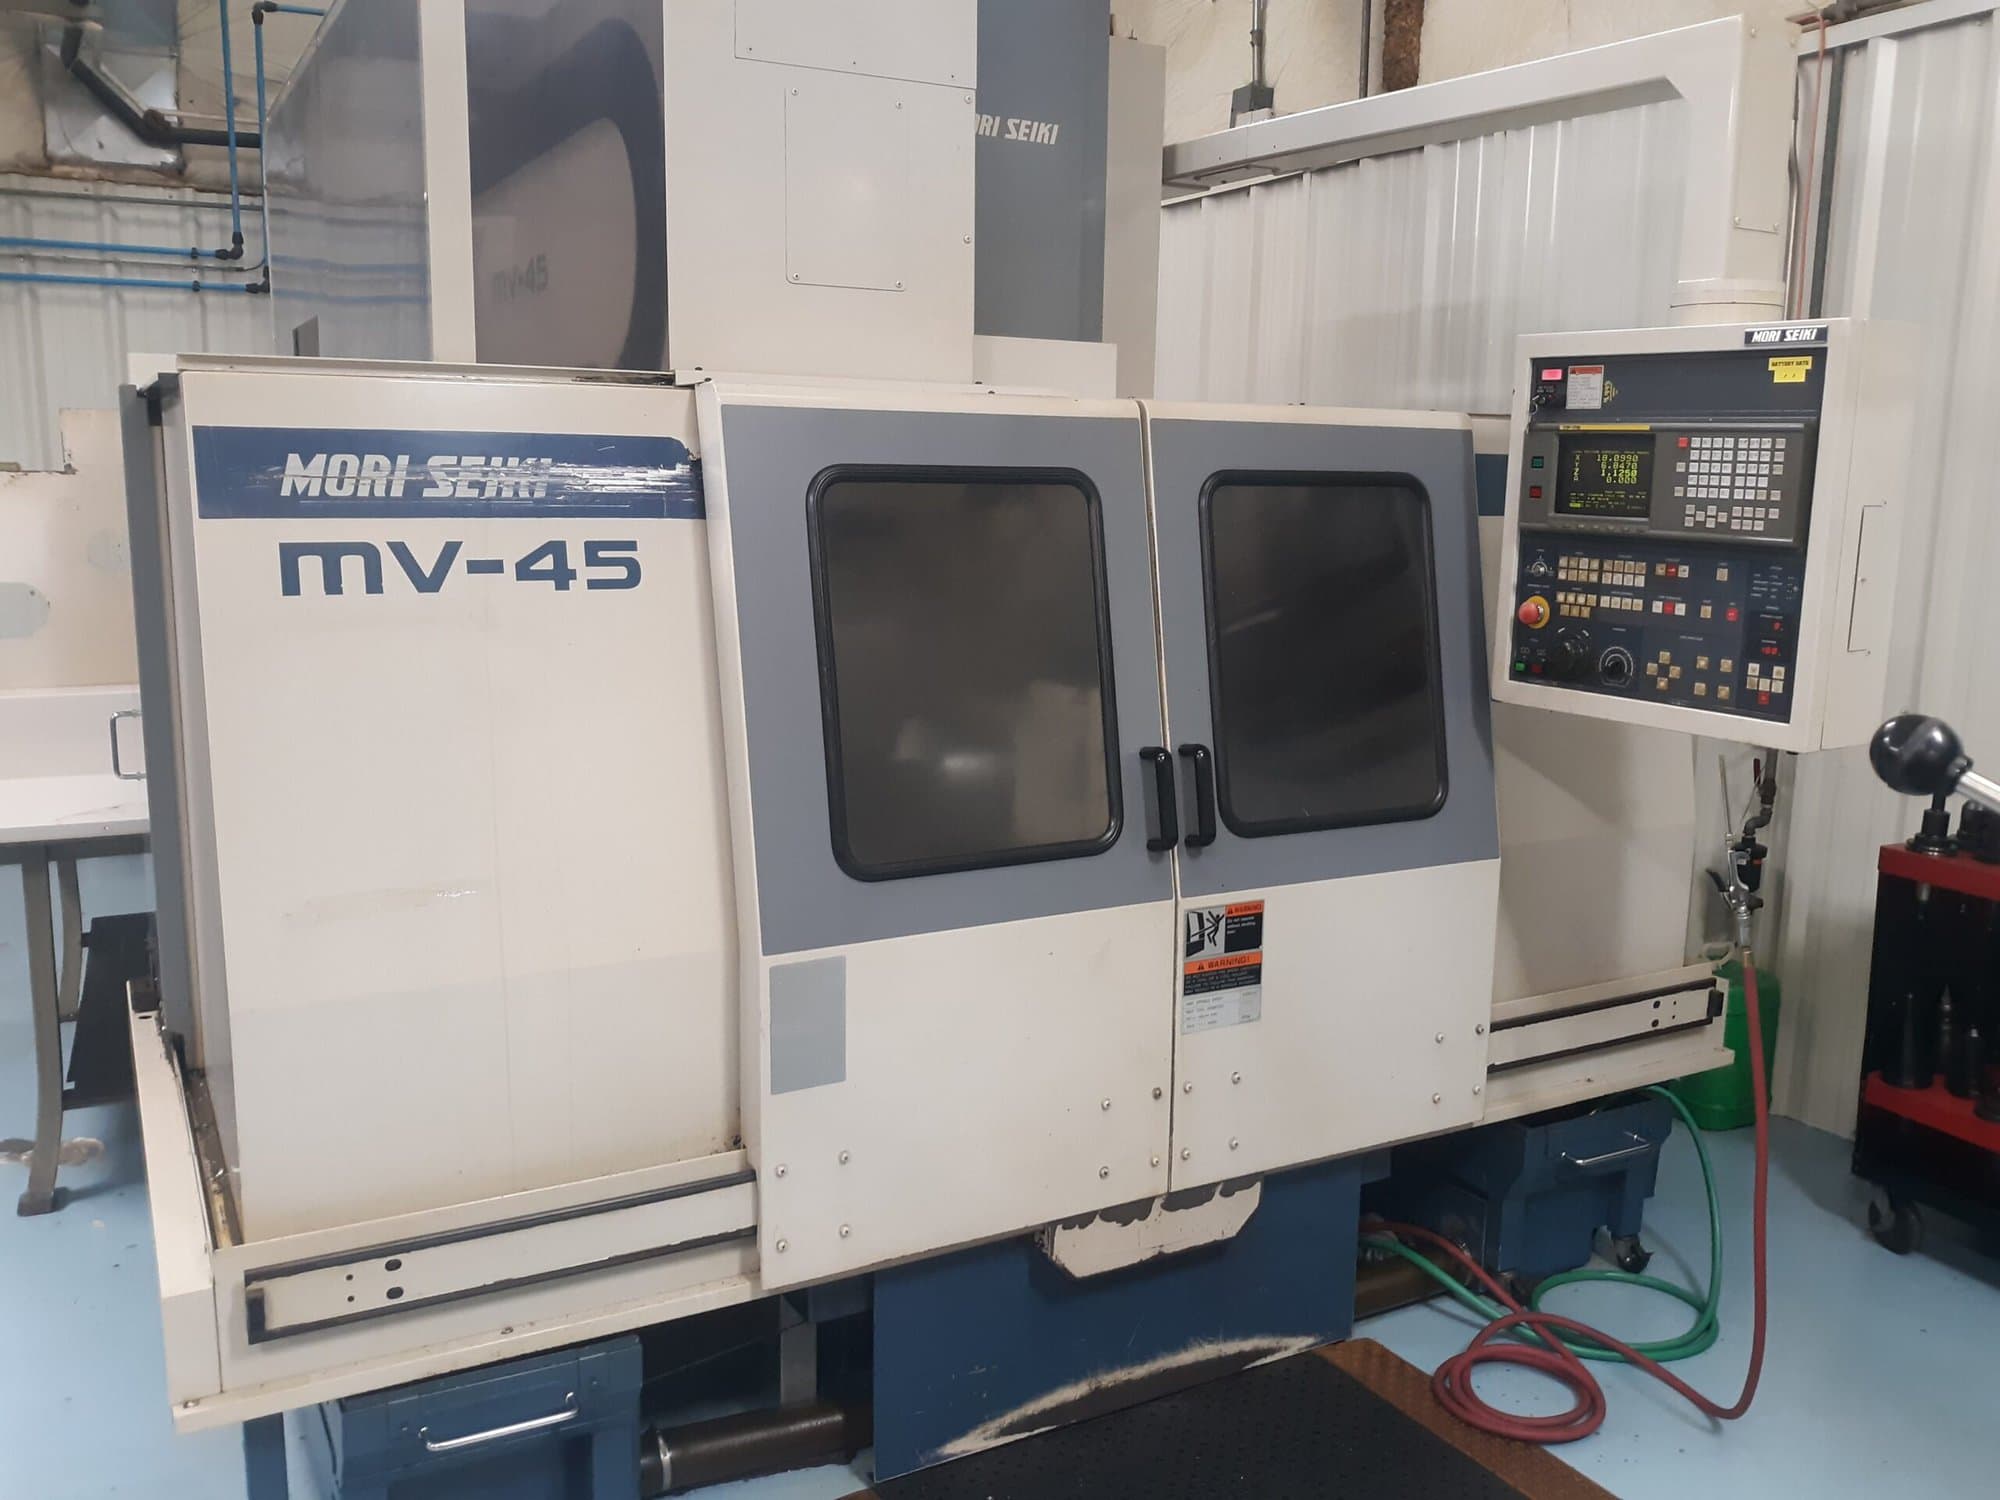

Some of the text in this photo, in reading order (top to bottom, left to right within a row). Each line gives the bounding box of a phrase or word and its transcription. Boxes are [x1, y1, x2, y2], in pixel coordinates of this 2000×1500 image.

[1004, 118, 1059, 145] SEIKI
[1751, 328, 1818, 343] MORI SEIKI
[279, 453, 553, 499] MORI SEIKI
